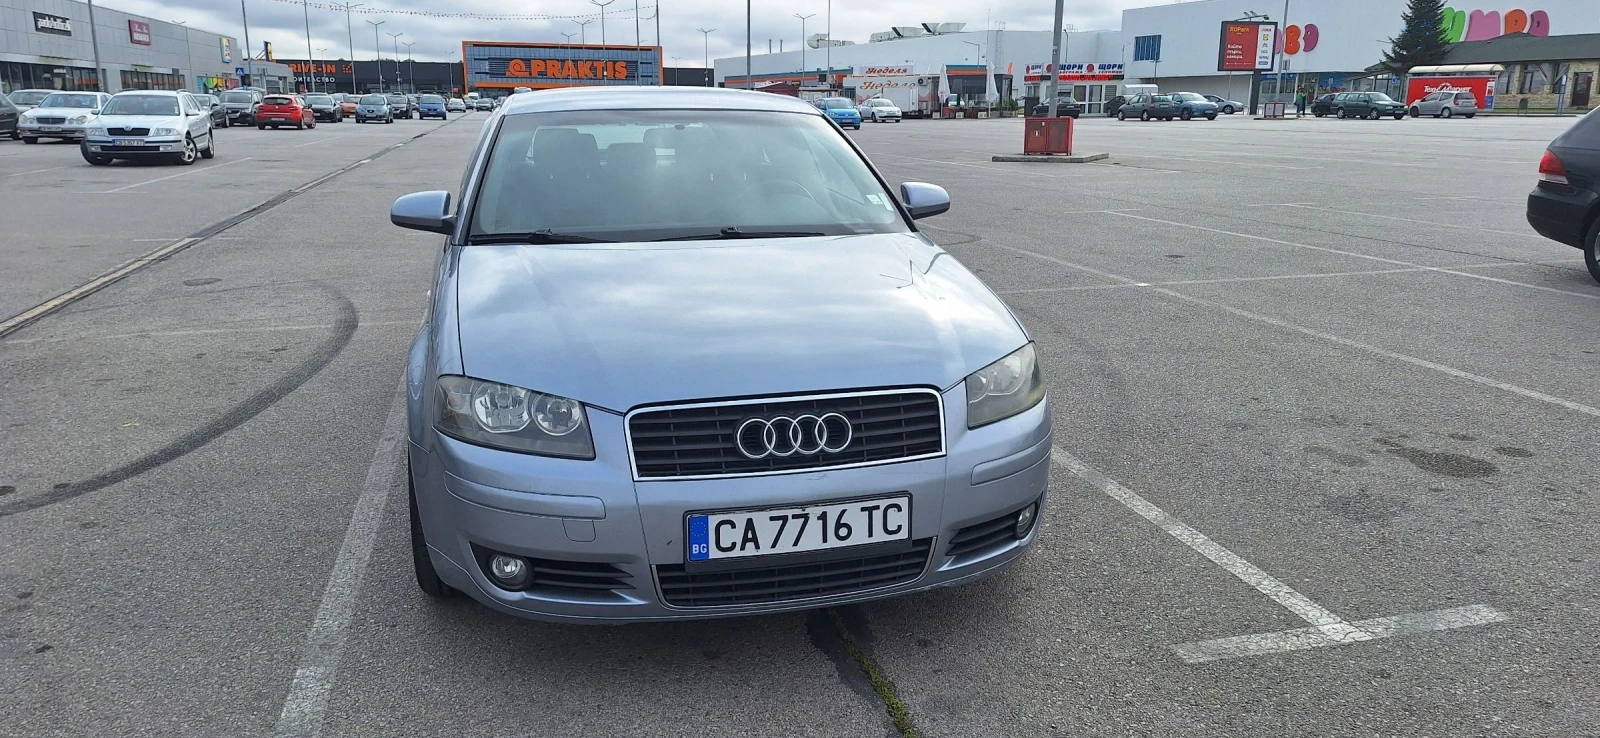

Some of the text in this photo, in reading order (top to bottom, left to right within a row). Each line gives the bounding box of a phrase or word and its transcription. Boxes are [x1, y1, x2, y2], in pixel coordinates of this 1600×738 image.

[530, 59, 627, 79] PRAKTIS
[1098, 63, 1123, 71] ЩОРИ
[714, 503, 903, 553] CA 7716 TC
[692, 544, 708, 554] BG
